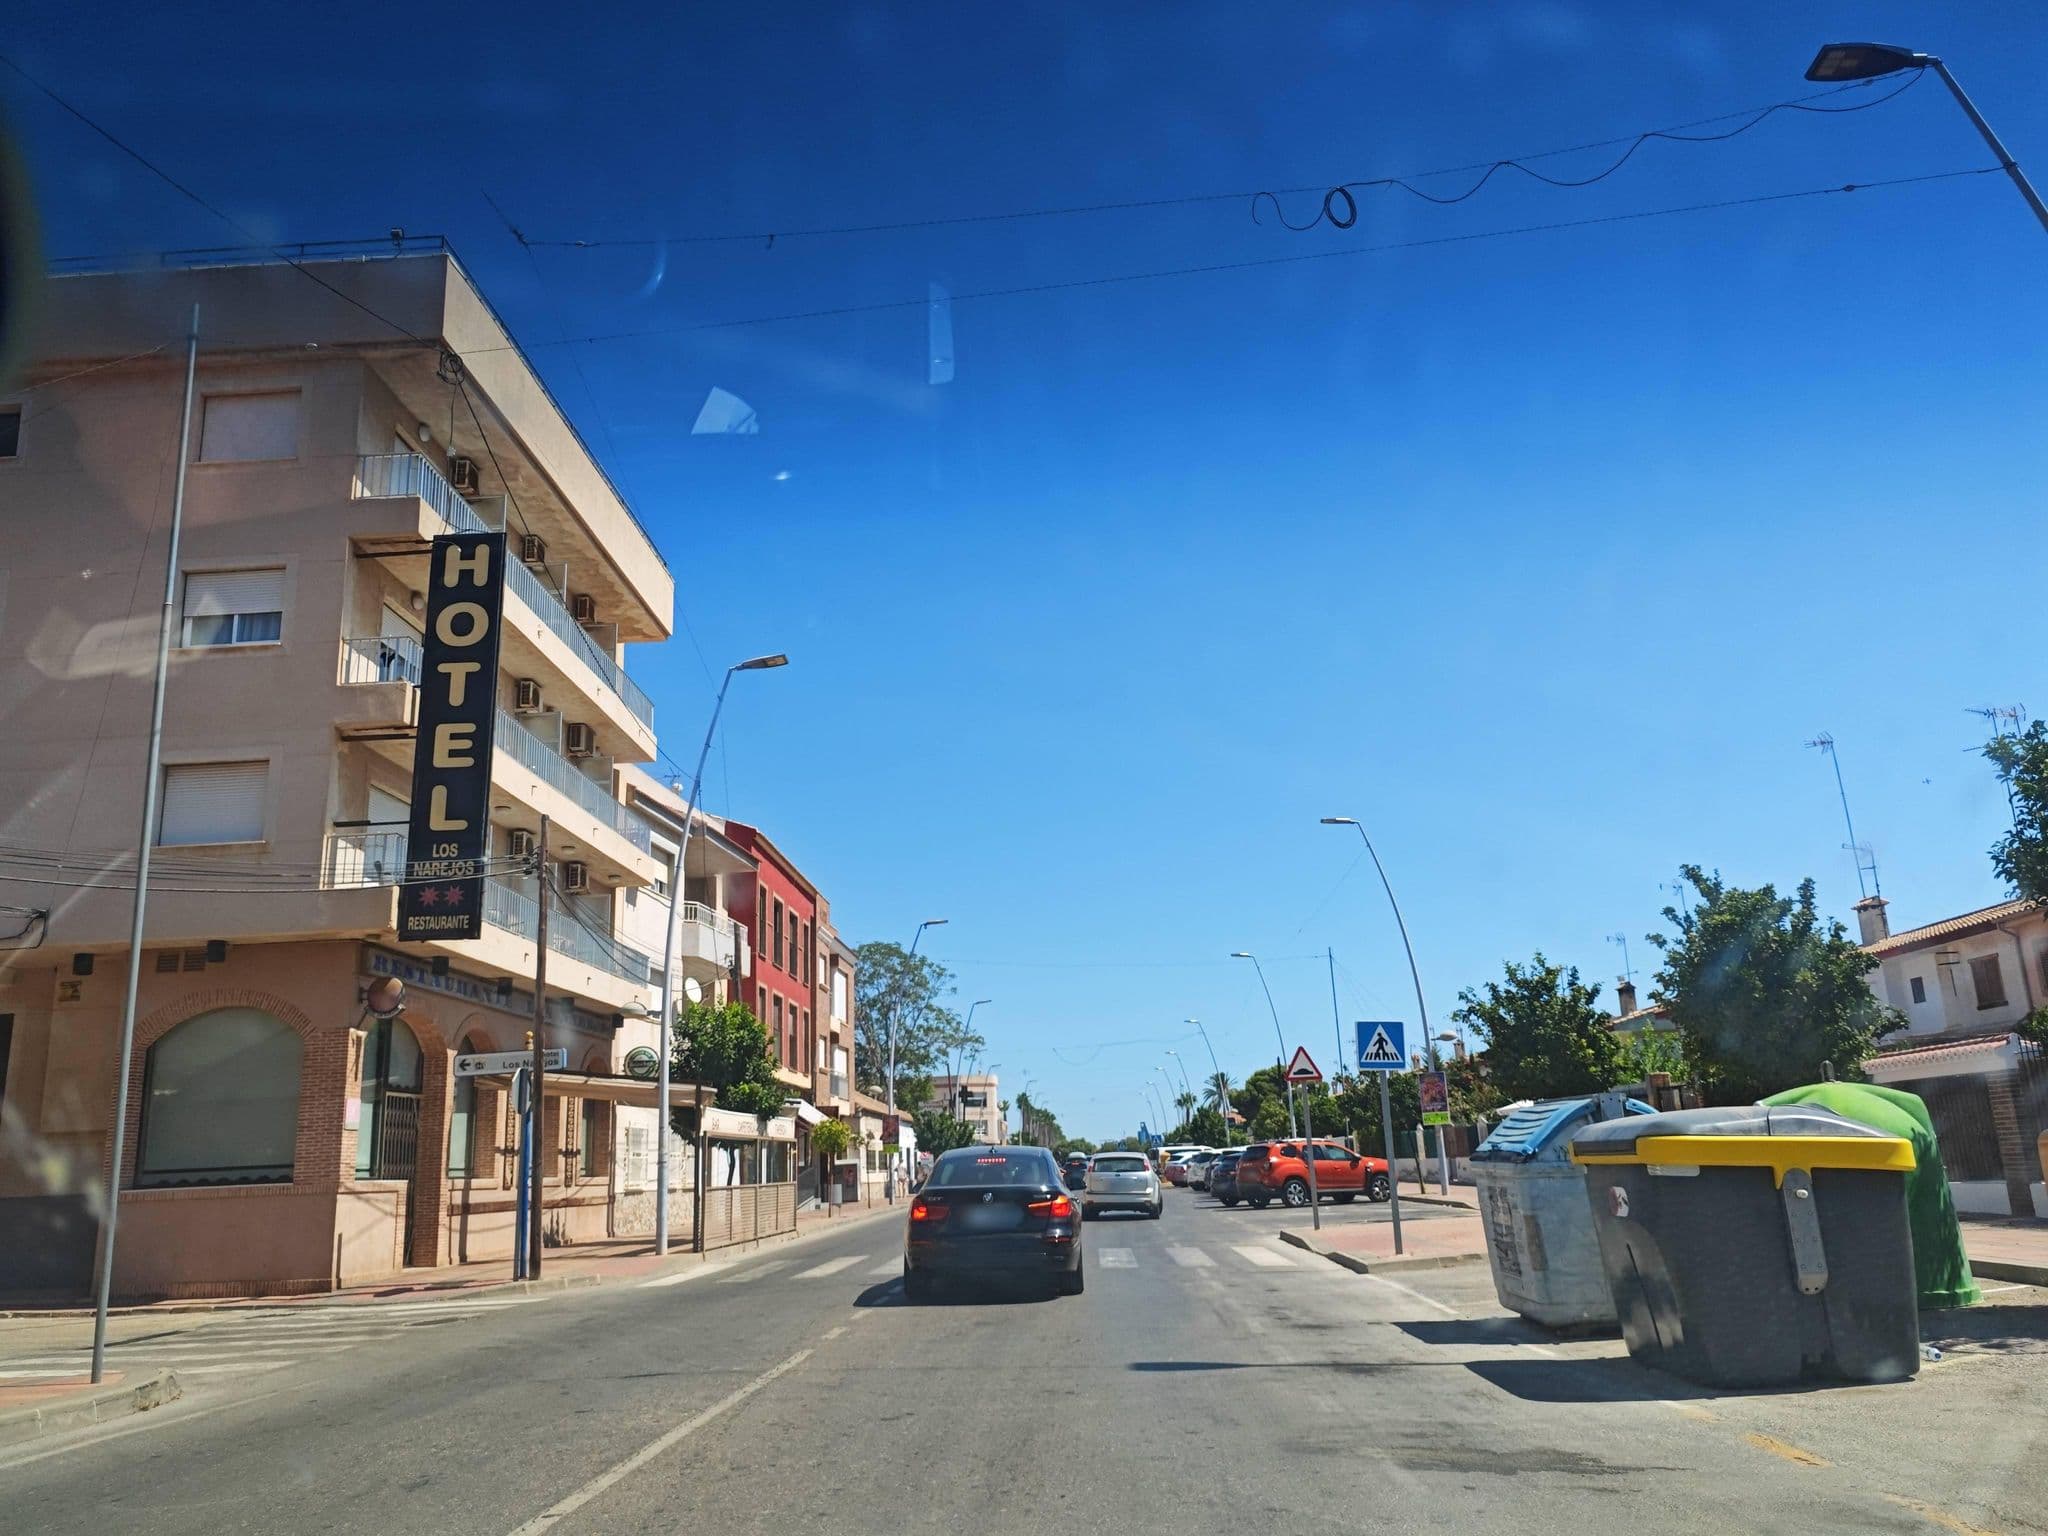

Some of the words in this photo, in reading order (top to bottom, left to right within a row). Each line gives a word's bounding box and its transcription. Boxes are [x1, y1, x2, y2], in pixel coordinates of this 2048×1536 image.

[429, 543, 490, 831] HOTEL
[432, 843, 459, 858] LOS
[413, 861, 475, 877] NAREJOS
[407, 915, 470, 931] RESTAURANTE
[503, 1060, 520, 1070] Los
